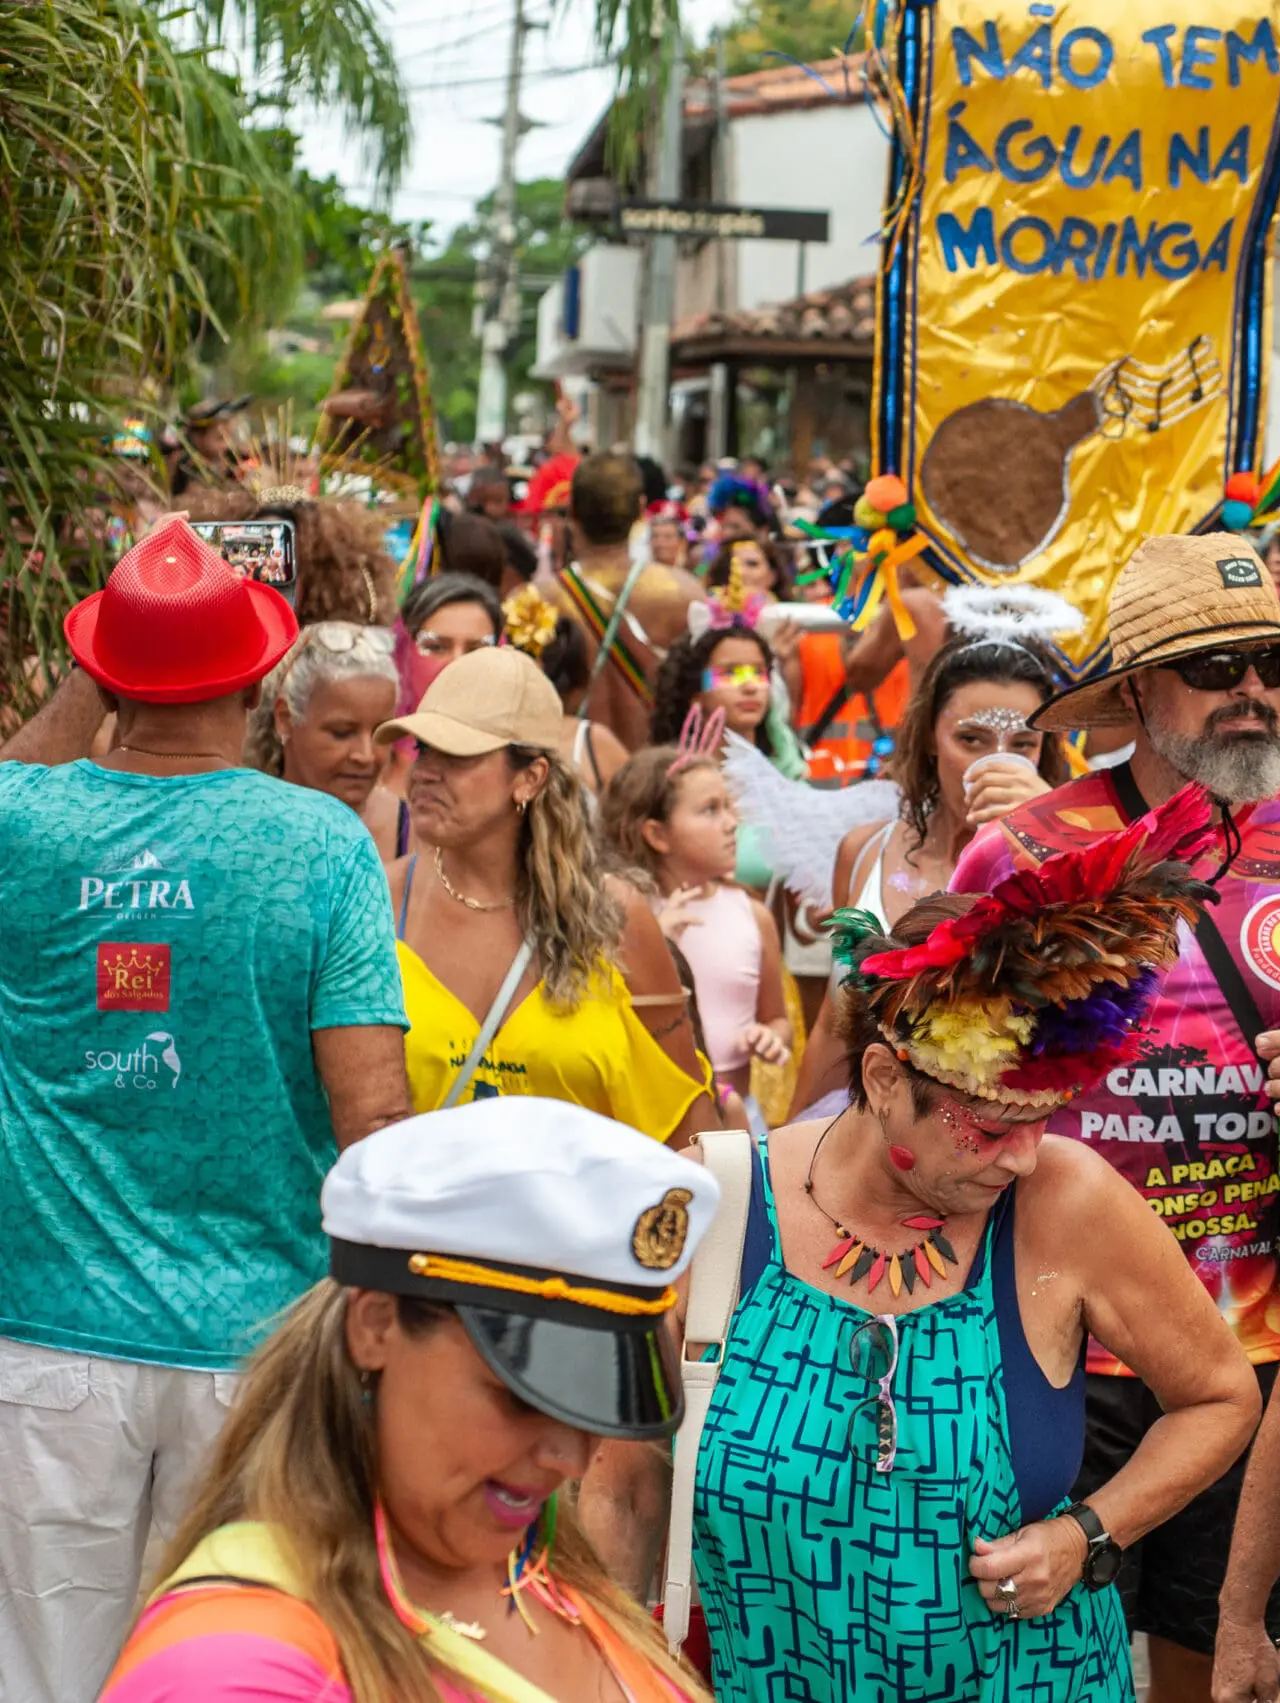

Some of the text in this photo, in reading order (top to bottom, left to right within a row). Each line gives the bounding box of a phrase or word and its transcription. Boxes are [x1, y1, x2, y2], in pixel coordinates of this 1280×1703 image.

[951, 3, 1280, 90] NÃO TEM
[943, 101, 1251, 192] ÁGUA NA
[935, 206, 1234, 282] MORINGA
[78, 876, 195, 911] PETRA
[115, 969, 153, 989] Rei
[84, 1042, 159, 1073] south
[114, 1073, 126, 1088] &
[1106, 1064, 1266, 1096] CARNAV
[1081, 1111, 1279, 1143] PARA TOD
[1146, 1167, 1167, 1187] A
[1171, 1153, 1256, 1185] PRAÇA
[1147, 1173, 1280, 1217] ONSO PENA
[1195, 1240, 1271, 1262] CARNAVAL
